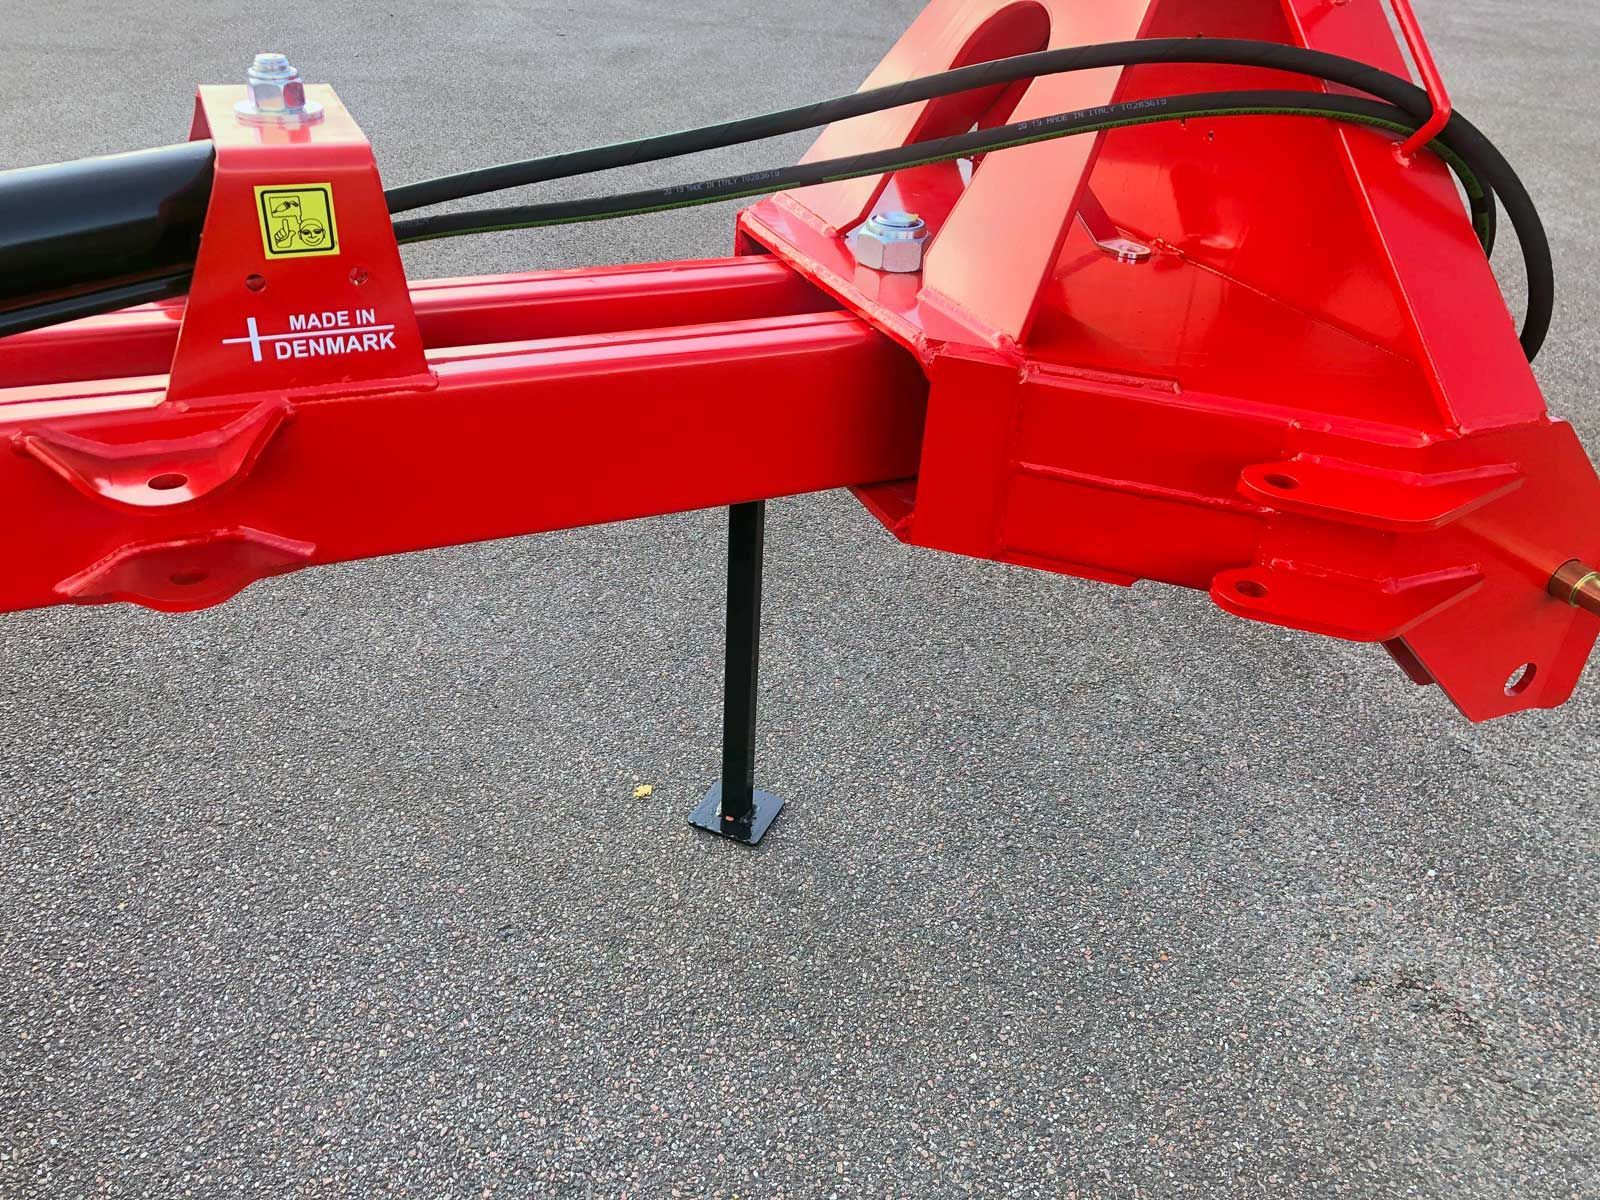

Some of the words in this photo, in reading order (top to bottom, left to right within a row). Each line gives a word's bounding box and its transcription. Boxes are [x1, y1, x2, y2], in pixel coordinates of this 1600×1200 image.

[1046, 117, 1068, 125] MADE
[1089, 105, 1115, 117] ITALY
[718, 178, 738, 188] ITALY
[289, 310, 349, 330] MADE
[355, 308, 375, 325] IN
[275, 331, 396, 359] DENMARK
